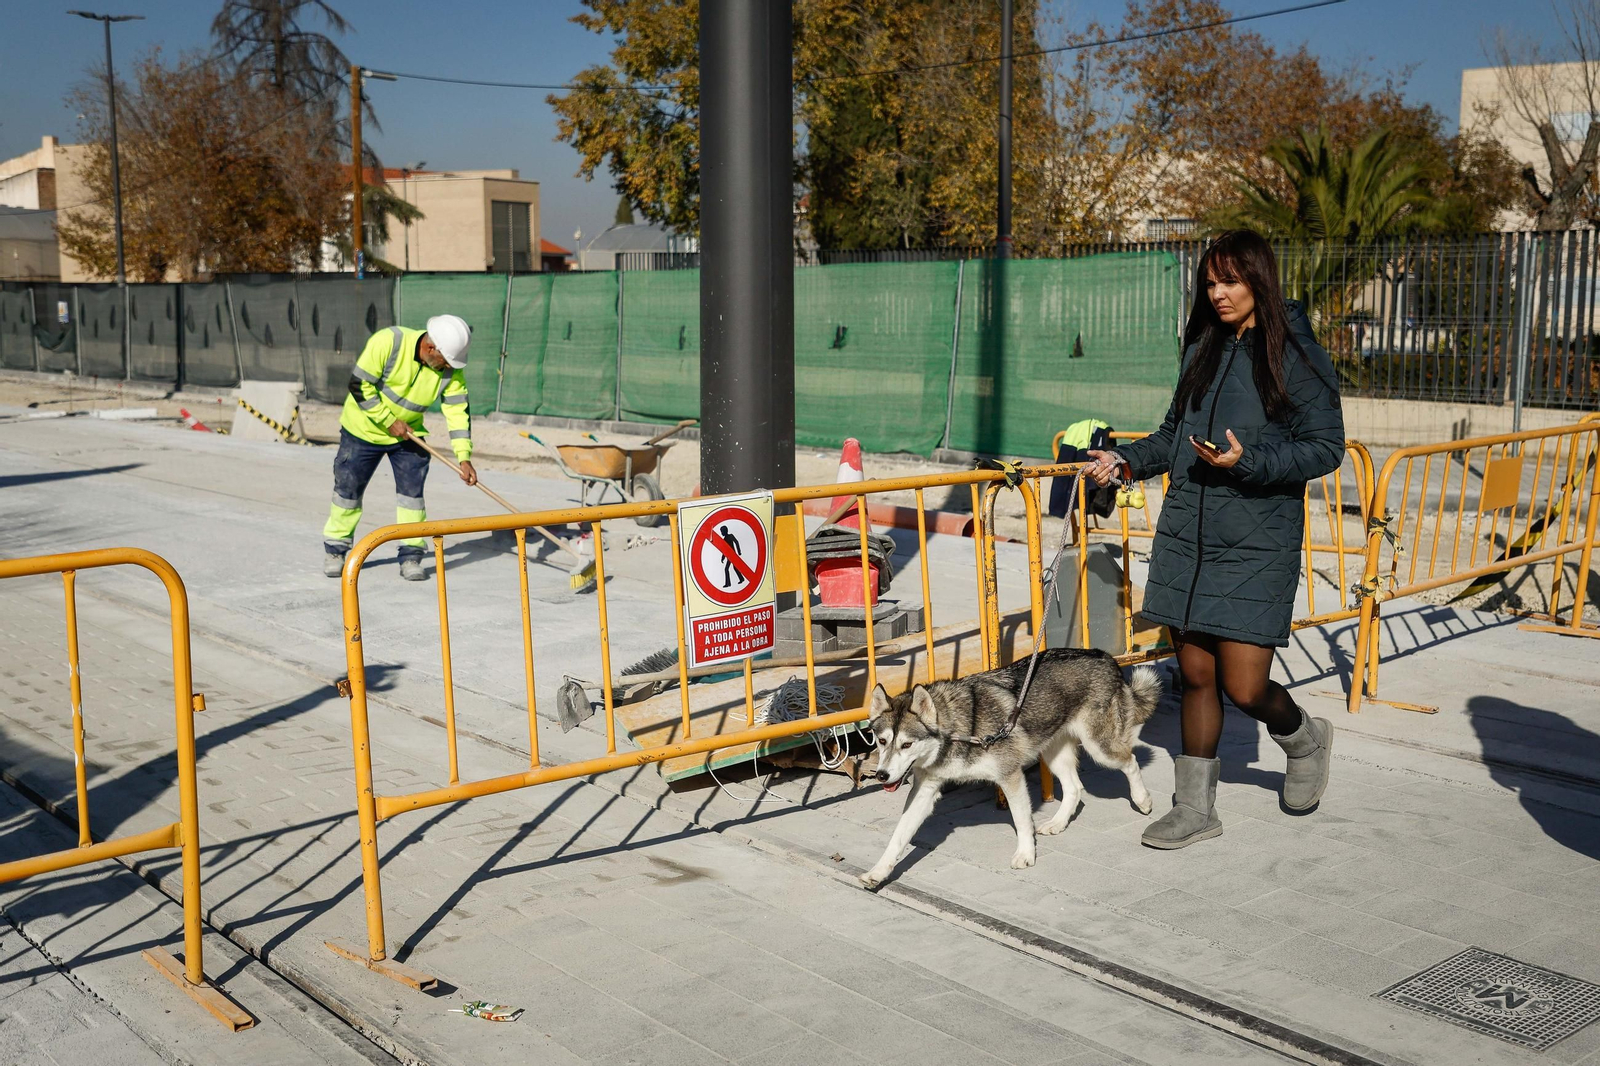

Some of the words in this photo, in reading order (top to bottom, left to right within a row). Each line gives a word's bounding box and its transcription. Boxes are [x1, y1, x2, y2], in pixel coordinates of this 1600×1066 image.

[698, 619, 741, 633] PROHIBIDO
[743, 615, 752, 625] EL
[753, 610, 771, 623] PASO
[704, 635, 711, 645] A
[712, 631, 733, 643] TODA
[735, 624, 767, 639] PERSONA
[704, 645, 731, 658] AJENA
[733, 643, 739, 652] A
[741, 640, 750, 651] LA
[752, 635, 769, 648] OBRA
